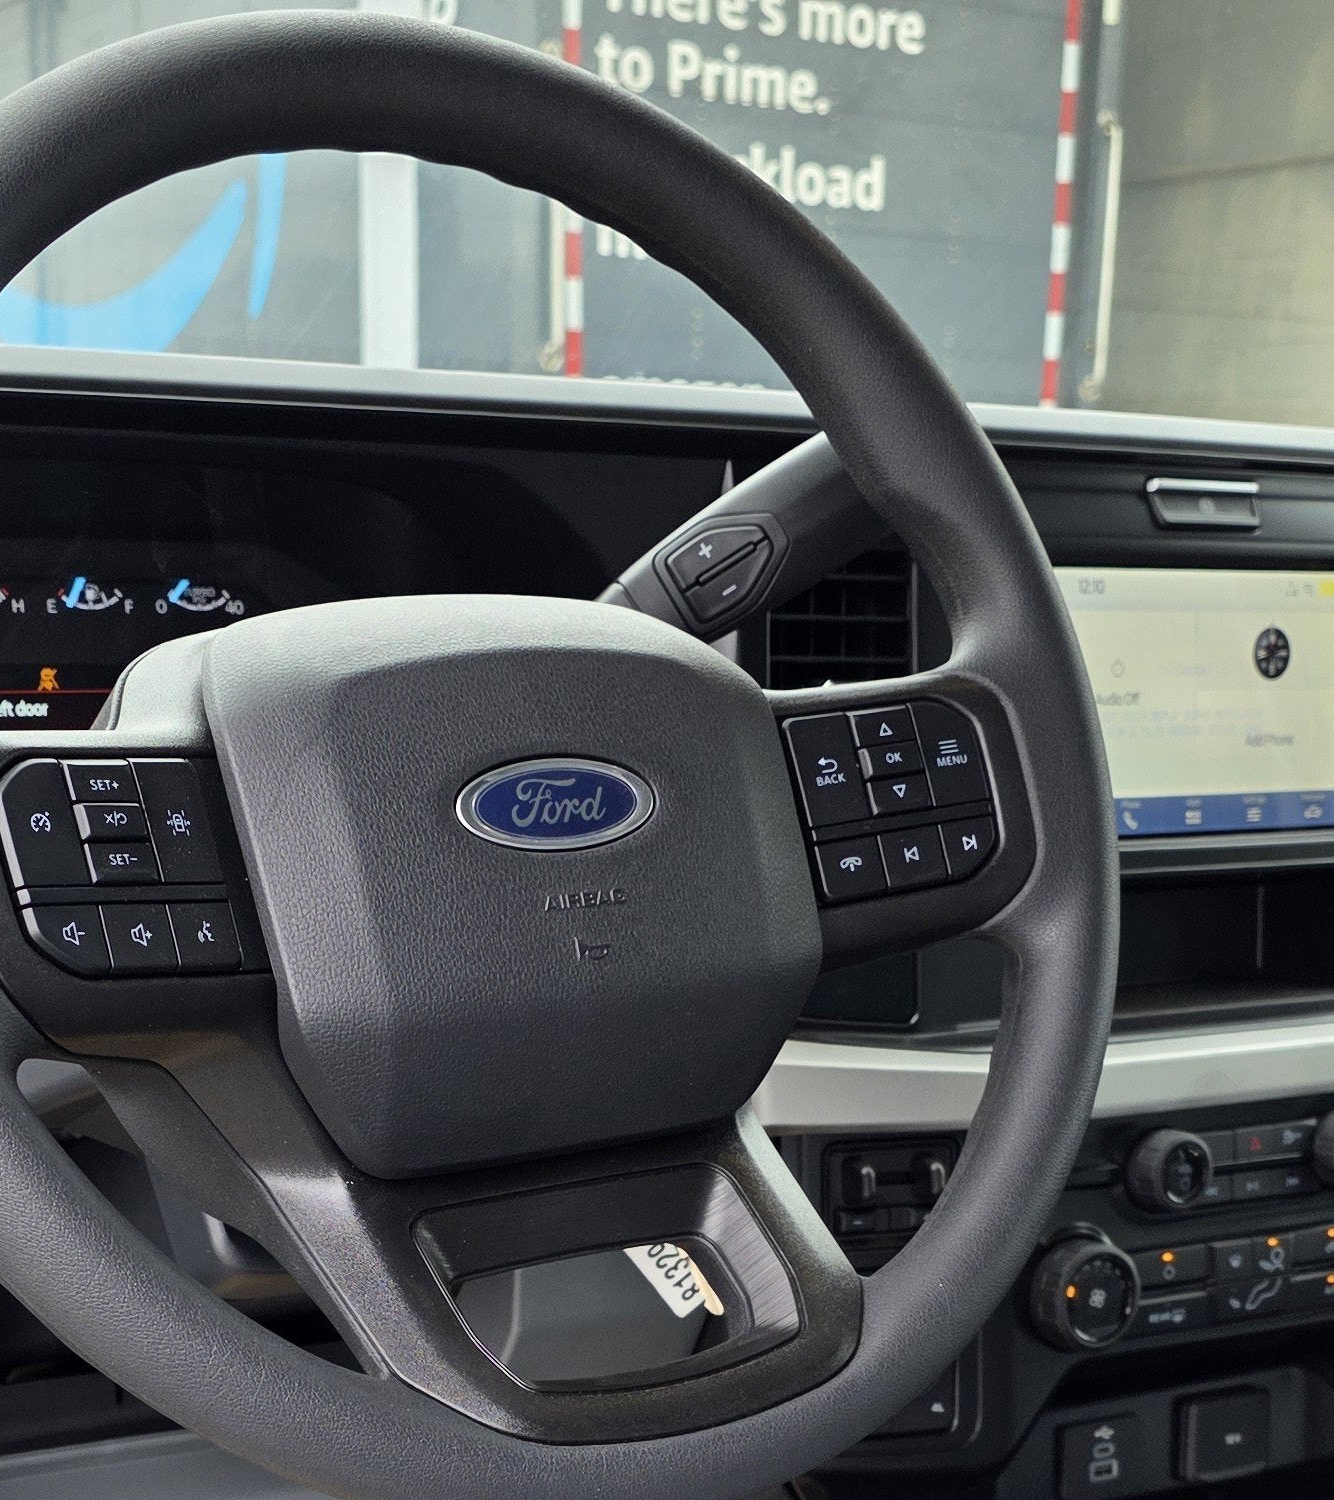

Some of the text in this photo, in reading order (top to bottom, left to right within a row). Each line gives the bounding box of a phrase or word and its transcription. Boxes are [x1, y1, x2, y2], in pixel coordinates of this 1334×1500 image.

[798, 2, 925, 54] more
[594, 33, 833, 115] to Prime.
[11, 598, 26, 613] H
[46, 599, 58, 614] E
[124, 599, 134, 614] F
[15, 700, 48, 717] door
[885, 751, 903, 763] OK
[936, 753, 968, 767] MENU
[815, 772, 846, 787] BACK
[511, 777, 606, 828] Ford
[544, 888, 626, 912] AIRBAG
